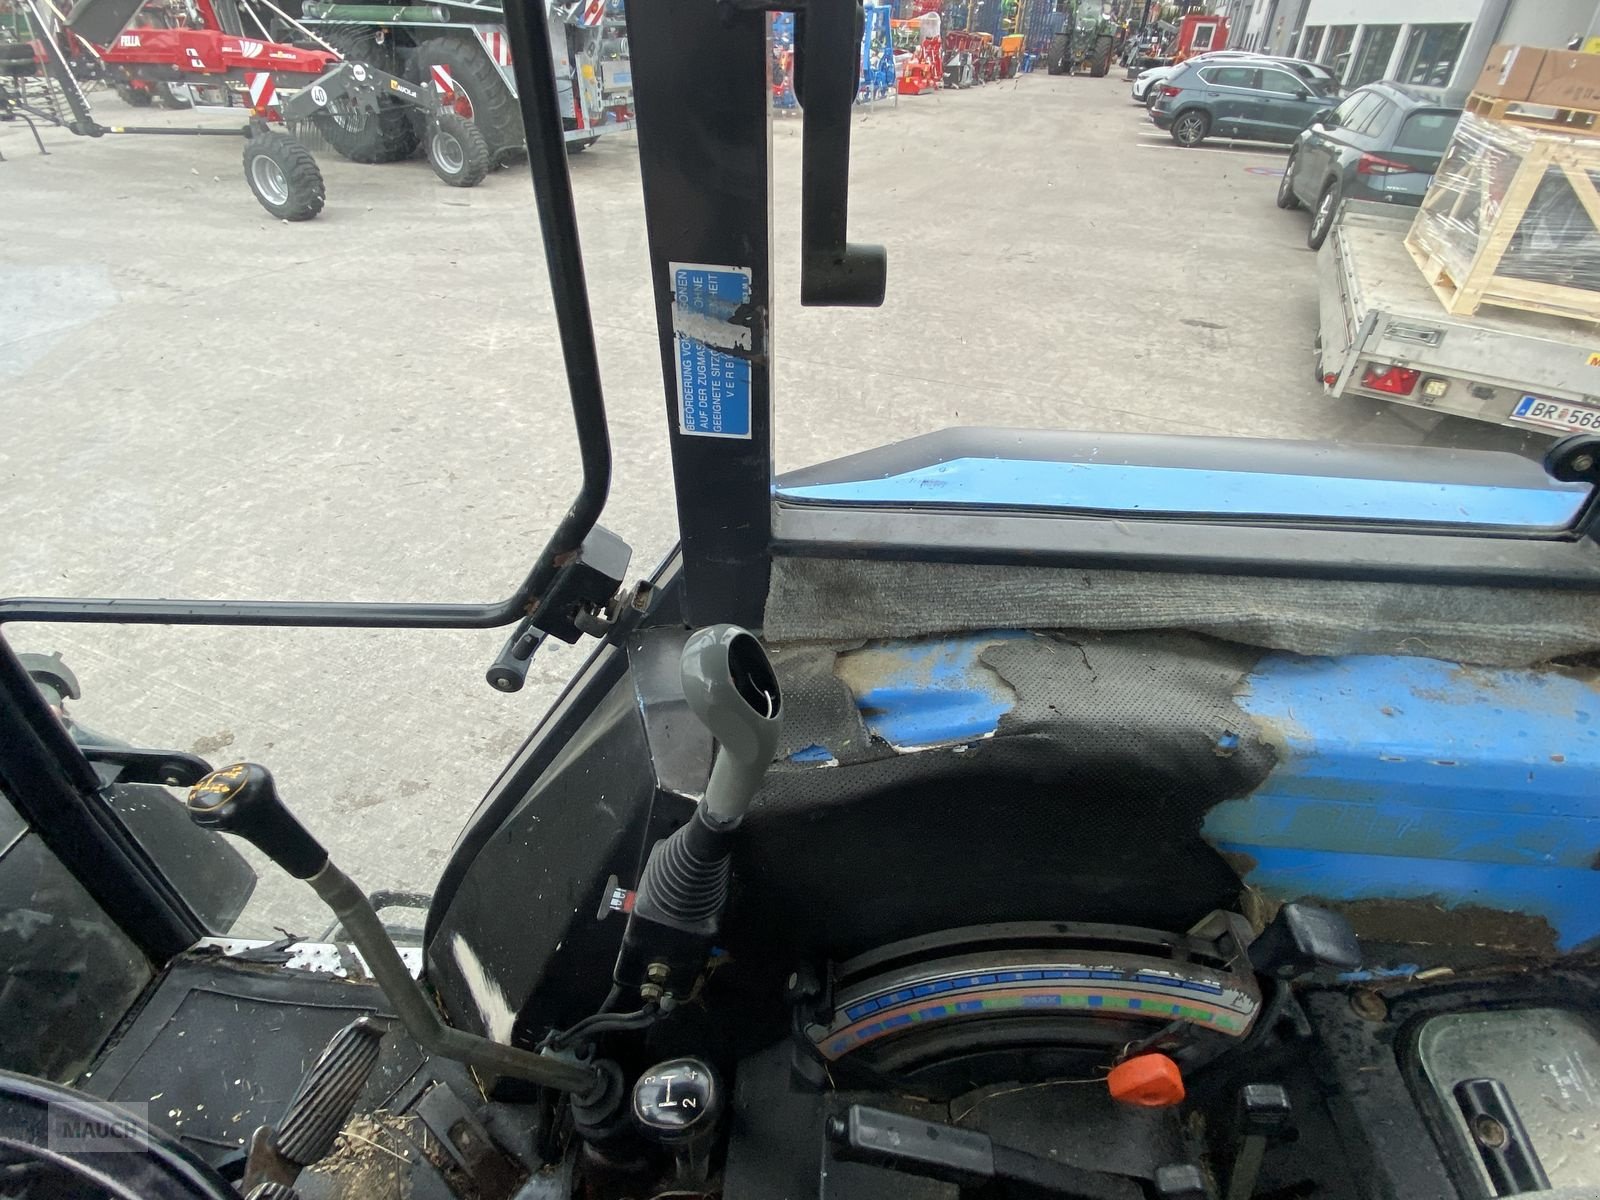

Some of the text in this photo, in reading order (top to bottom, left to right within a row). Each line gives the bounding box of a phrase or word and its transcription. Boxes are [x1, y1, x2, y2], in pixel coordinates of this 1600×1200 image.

[120, 36, 141, 47] FELLA
[696, 344, 707, 389] ZUGMAS
[698, 390, 708, 408] DER
[711, 380, 722, 432] GEEIGNETE
[1531, 402, 1558, 419] BR
[699, 411, 709, 429] AUF
[644, 1075, 656, 1085] 3
[682, 1070, 698, 1109] 2 4
